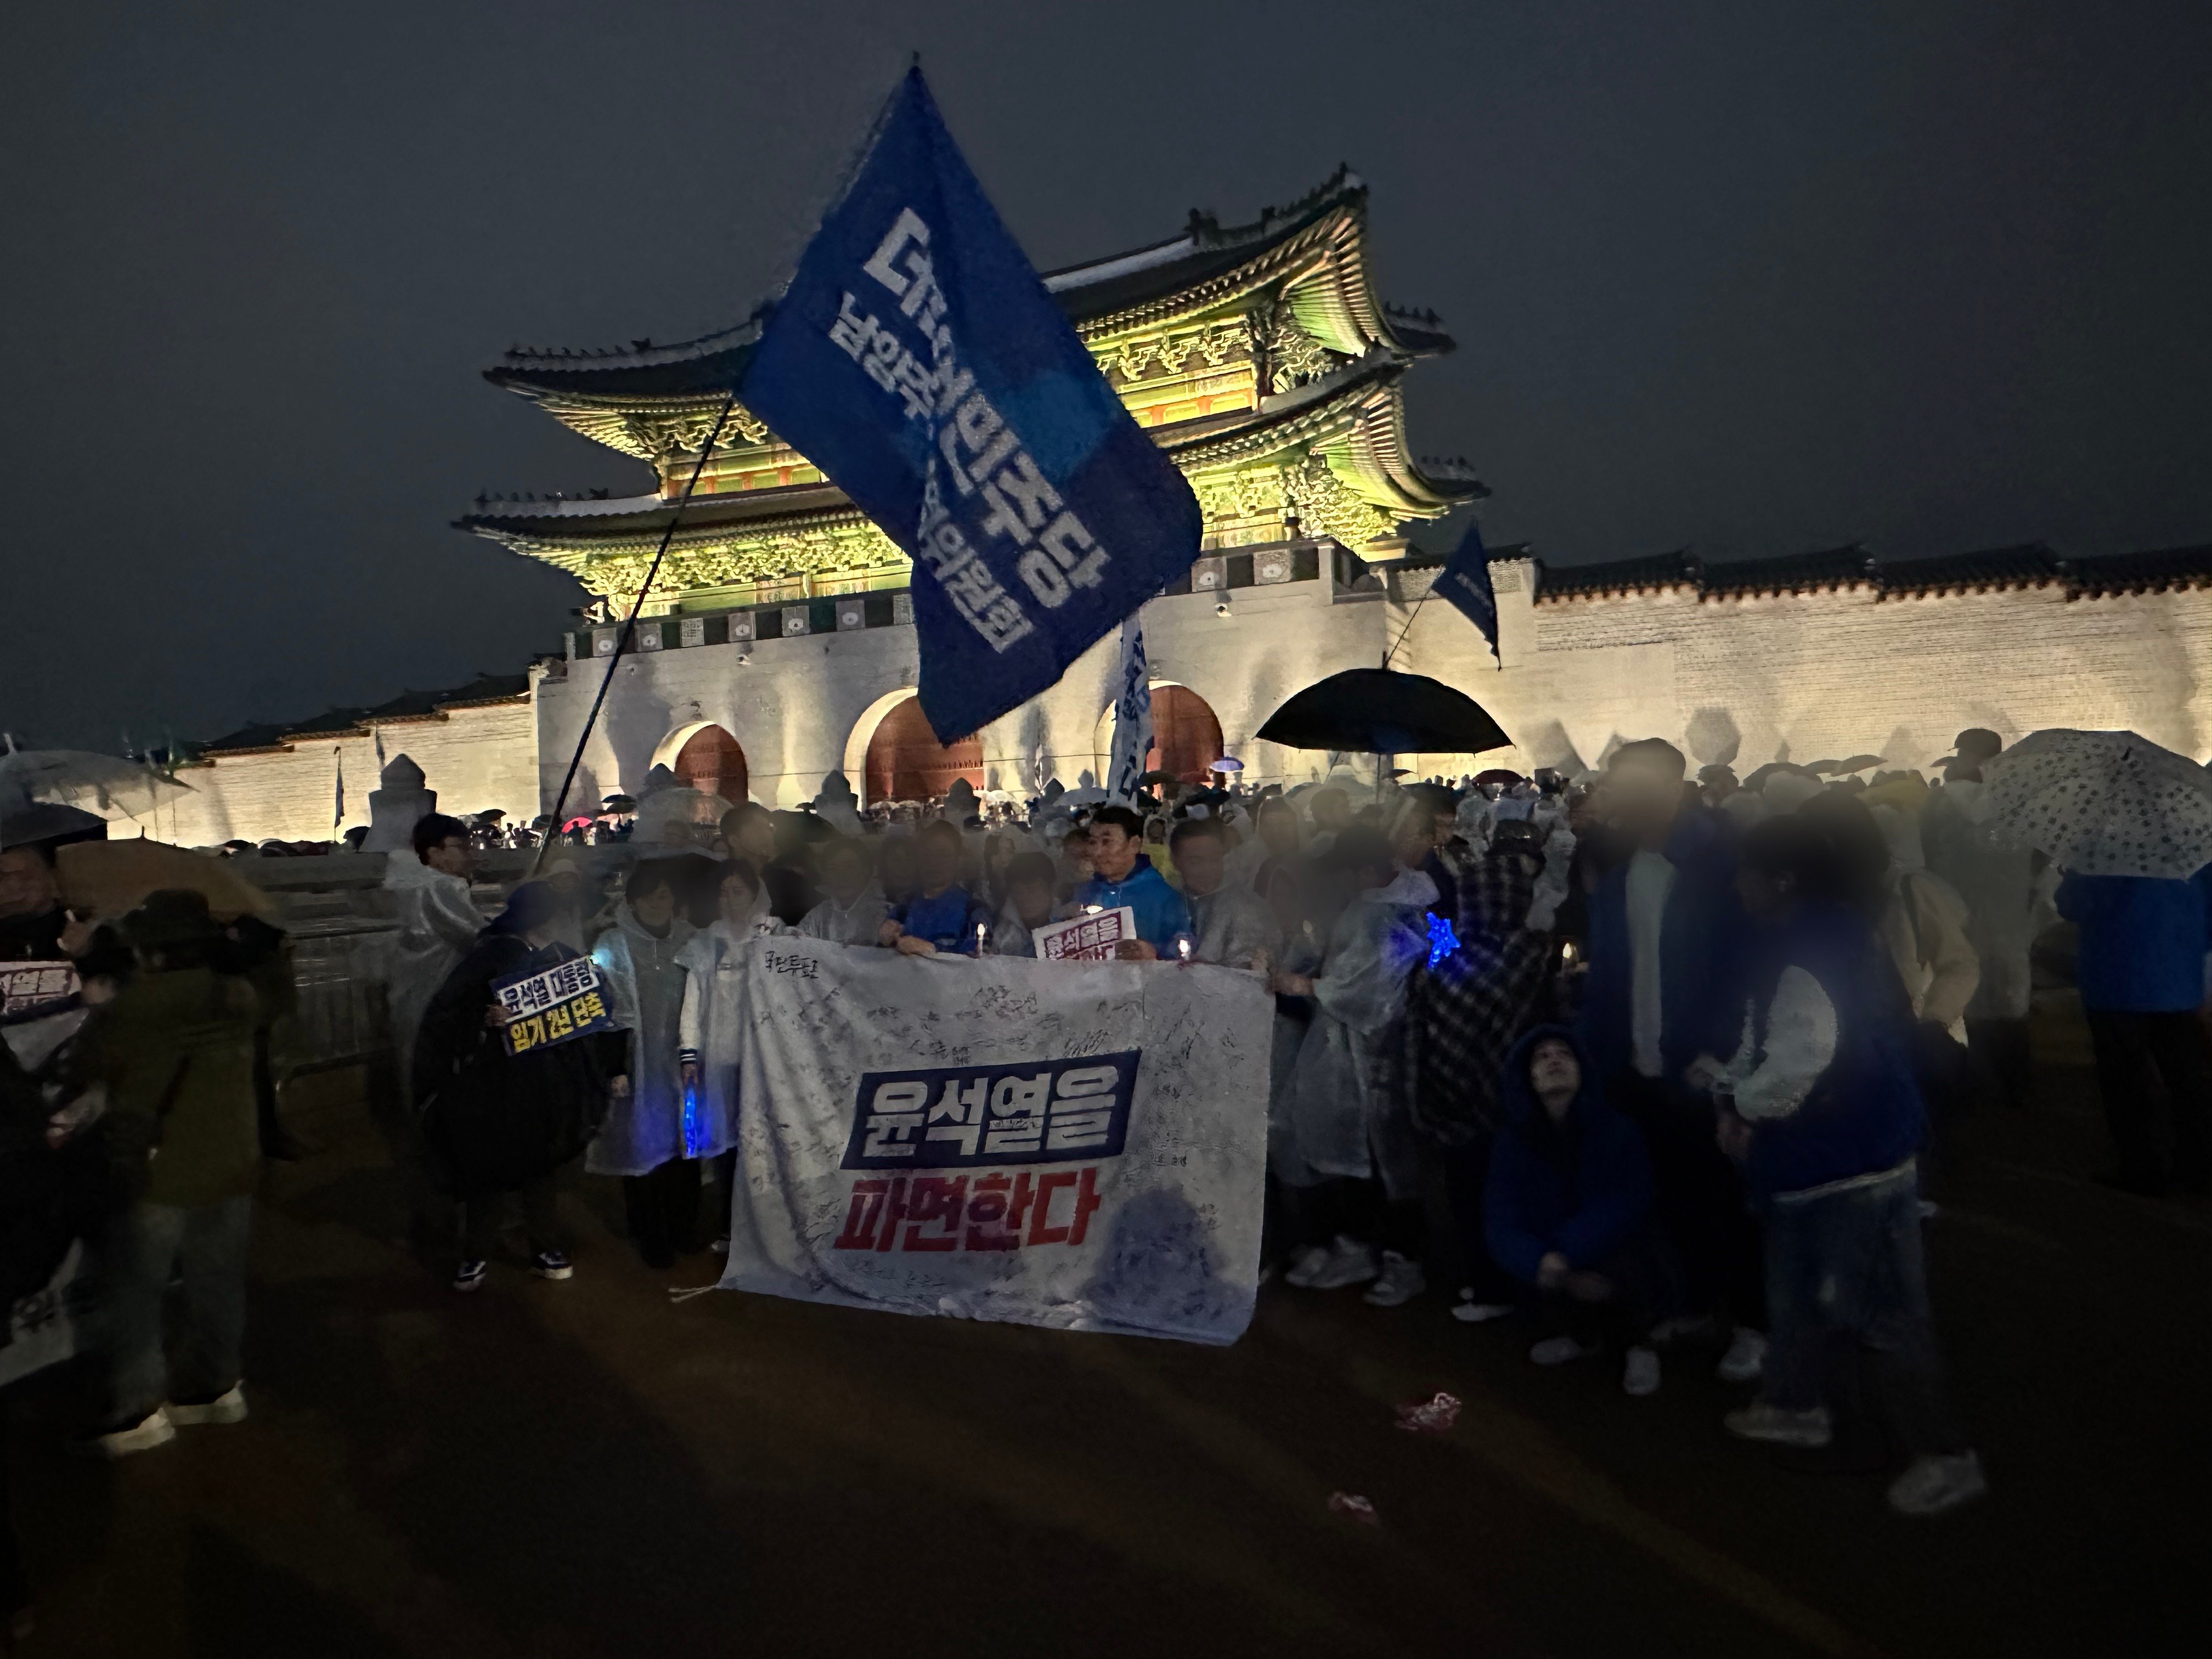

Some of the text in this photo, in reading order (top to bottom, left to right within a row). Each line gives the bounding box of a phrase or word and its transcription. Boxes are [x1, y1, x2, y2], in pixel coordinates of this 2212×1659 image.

[511, 1017, 546, 1052] 임기
[864, 1066, 1118, 1157] 윤석열을
[834, 1168, 1100, 1251] 파면한다
